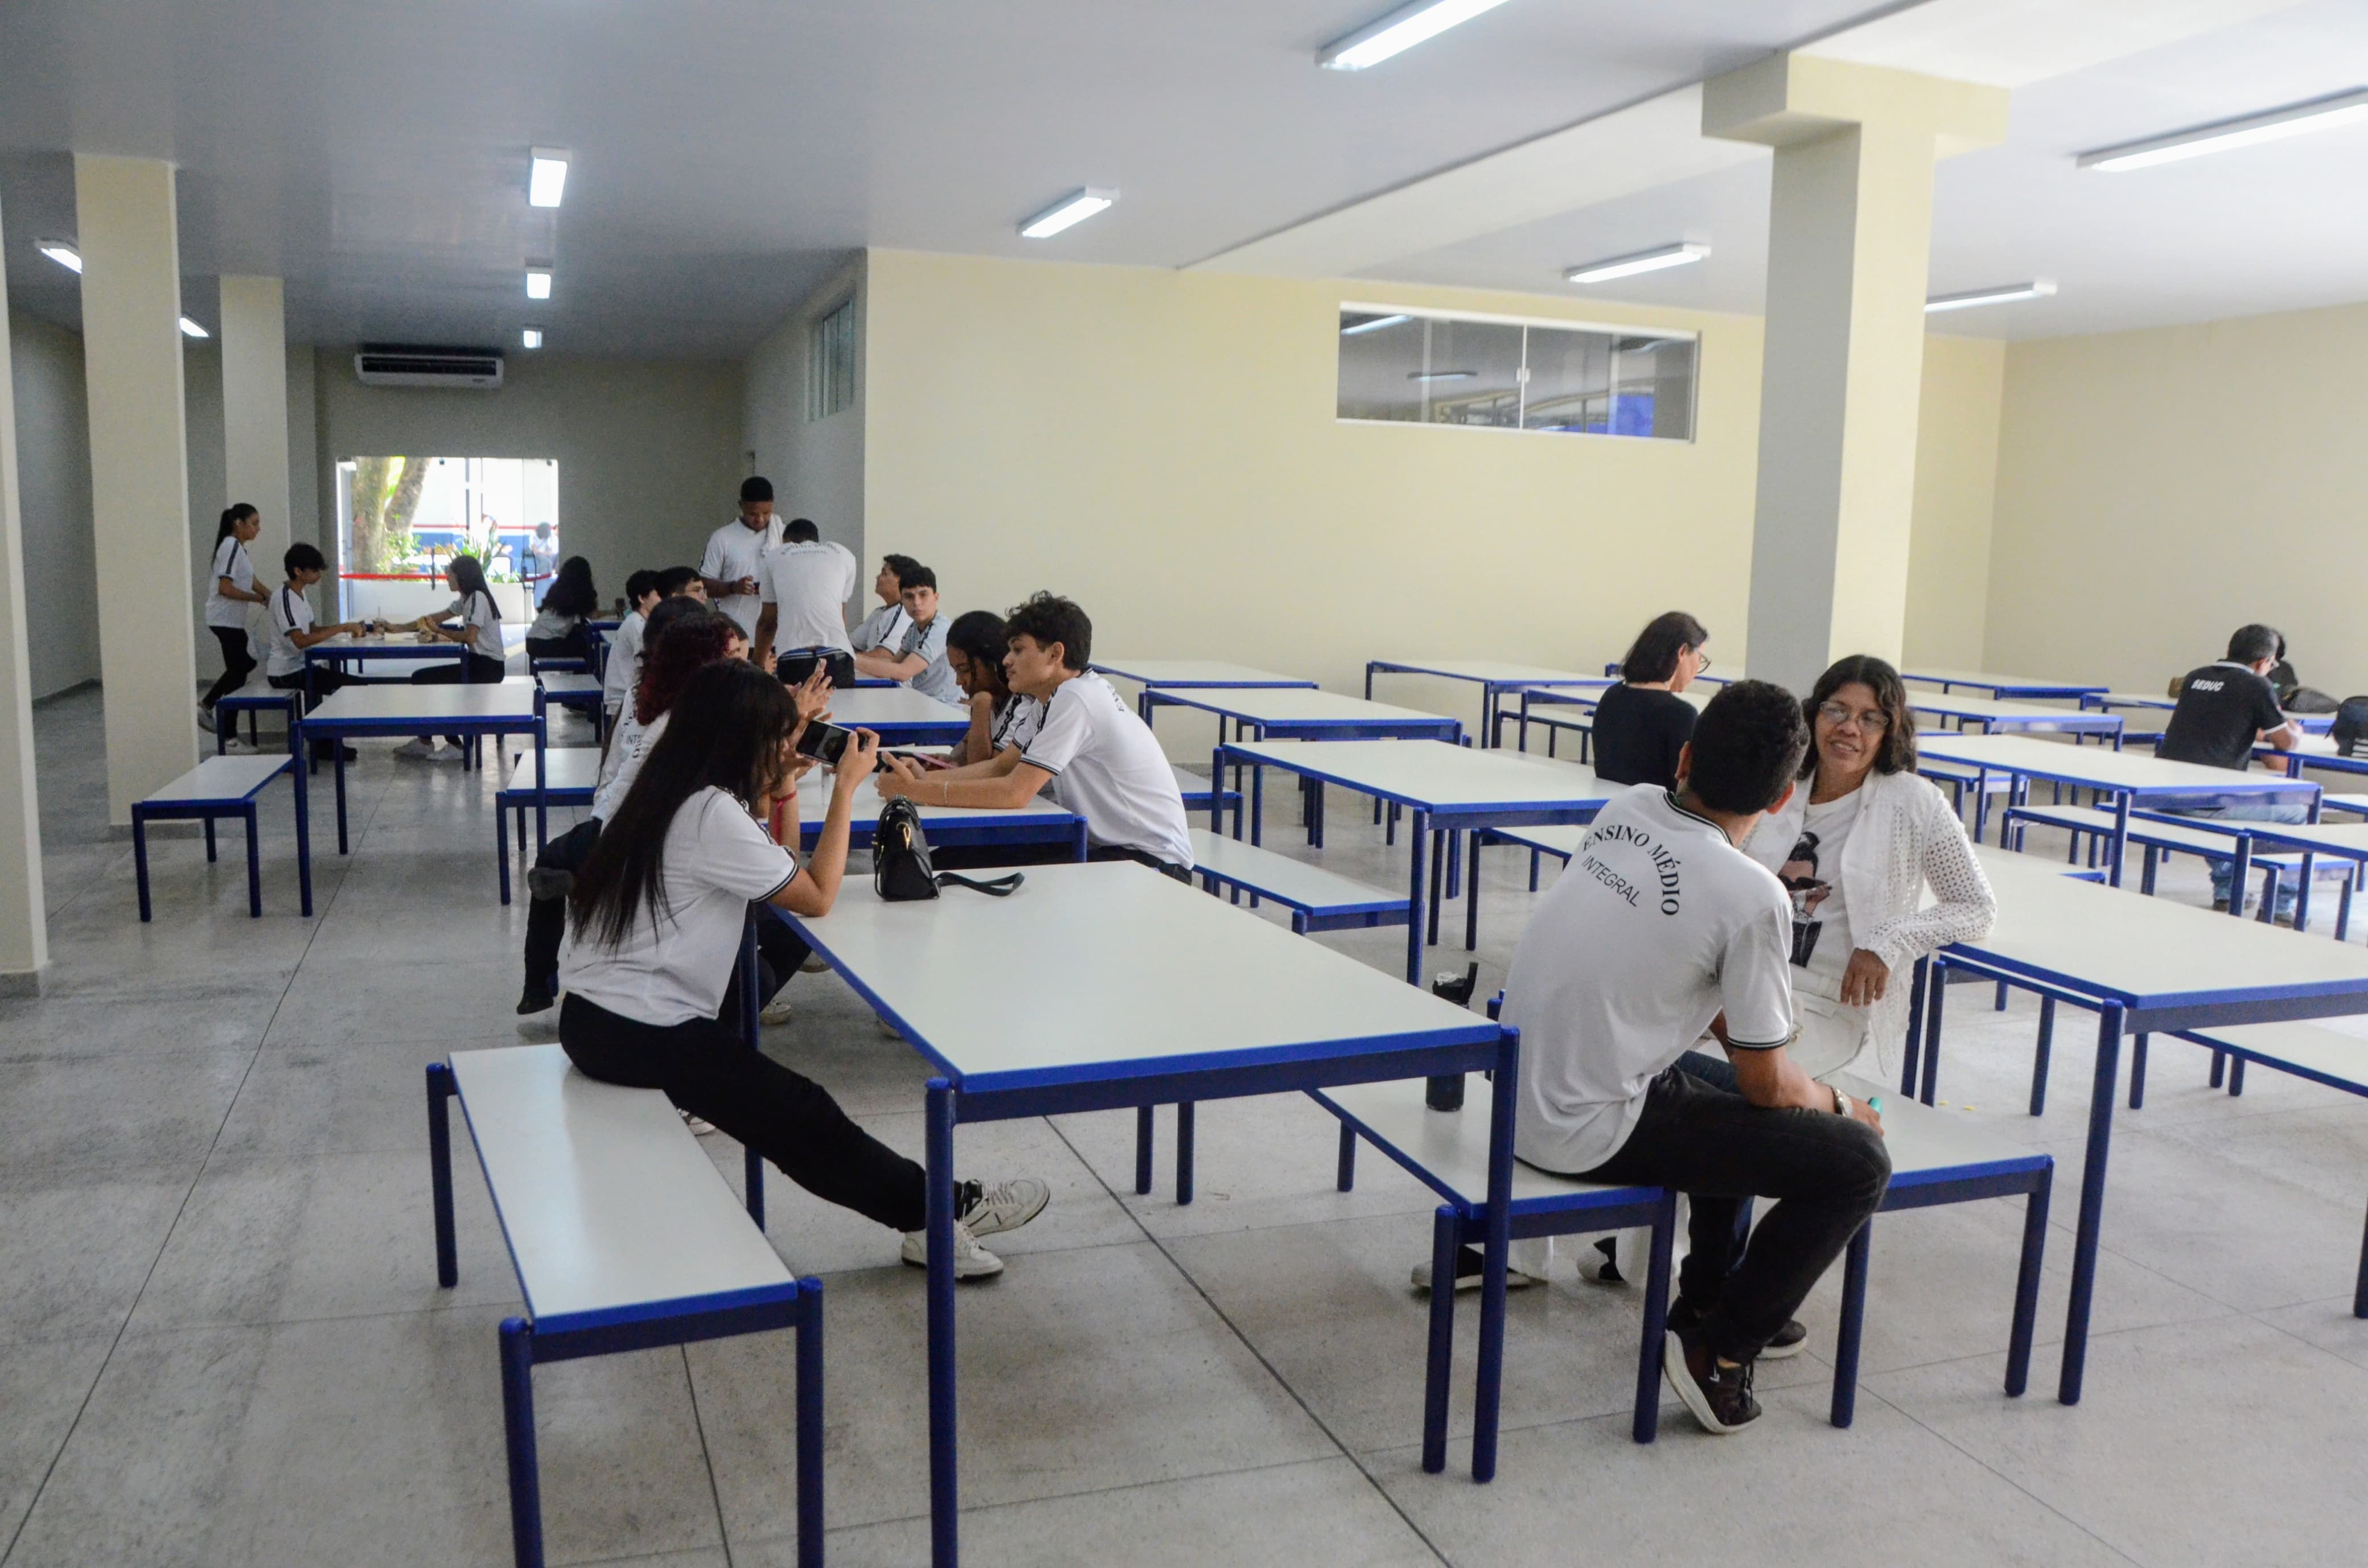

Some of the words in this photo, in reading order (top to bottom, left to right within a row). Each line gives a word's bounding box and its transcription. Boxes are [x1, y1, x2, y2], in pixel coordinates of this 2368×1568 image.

[1581, 855, 1640, 908] INTEGRAL
[1582, 825, 1650, 852] ENSINO
[1647, 843, 1681, 916] MÉDIO
